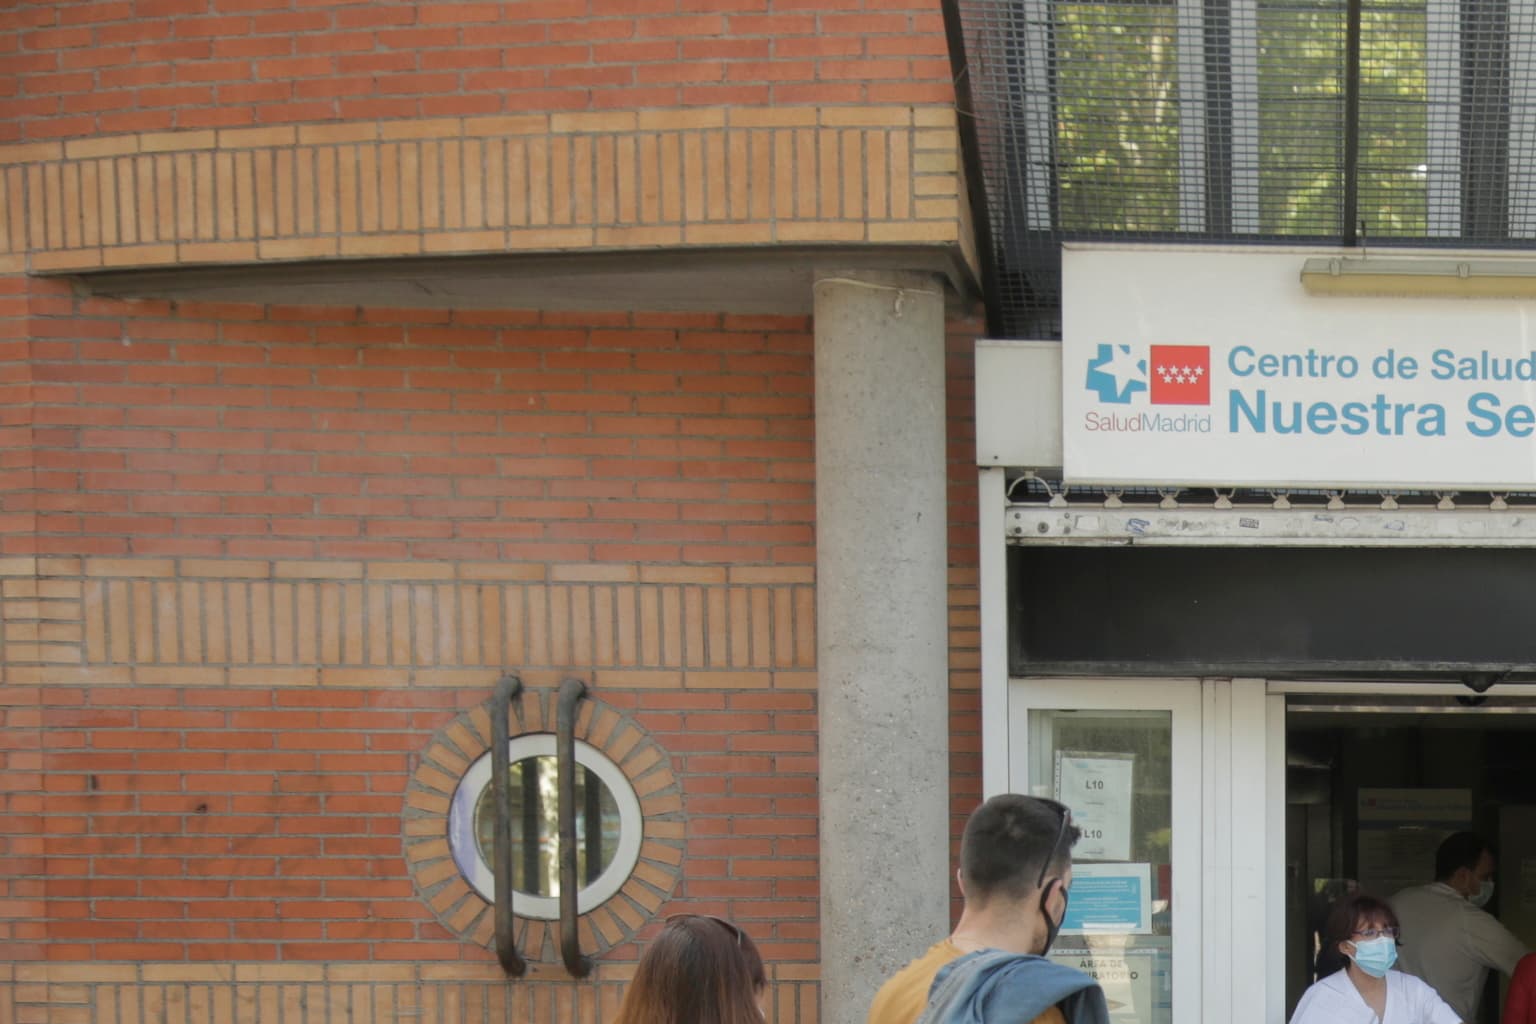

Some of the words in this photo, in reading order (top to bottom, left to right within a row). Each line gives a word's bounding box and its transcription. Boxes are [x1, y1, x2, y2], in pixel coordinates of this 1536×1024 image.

[1228, 345, 1360, 379] Centro
[1372, 348, 1419, 381] de
[1084, 412, 1211, 434] SaludMadrid
[1228, 389, 1447, 437] Nuestra
[1085, 779, 1104, 790] L10
[1084, 829, 1102, 839] L10
